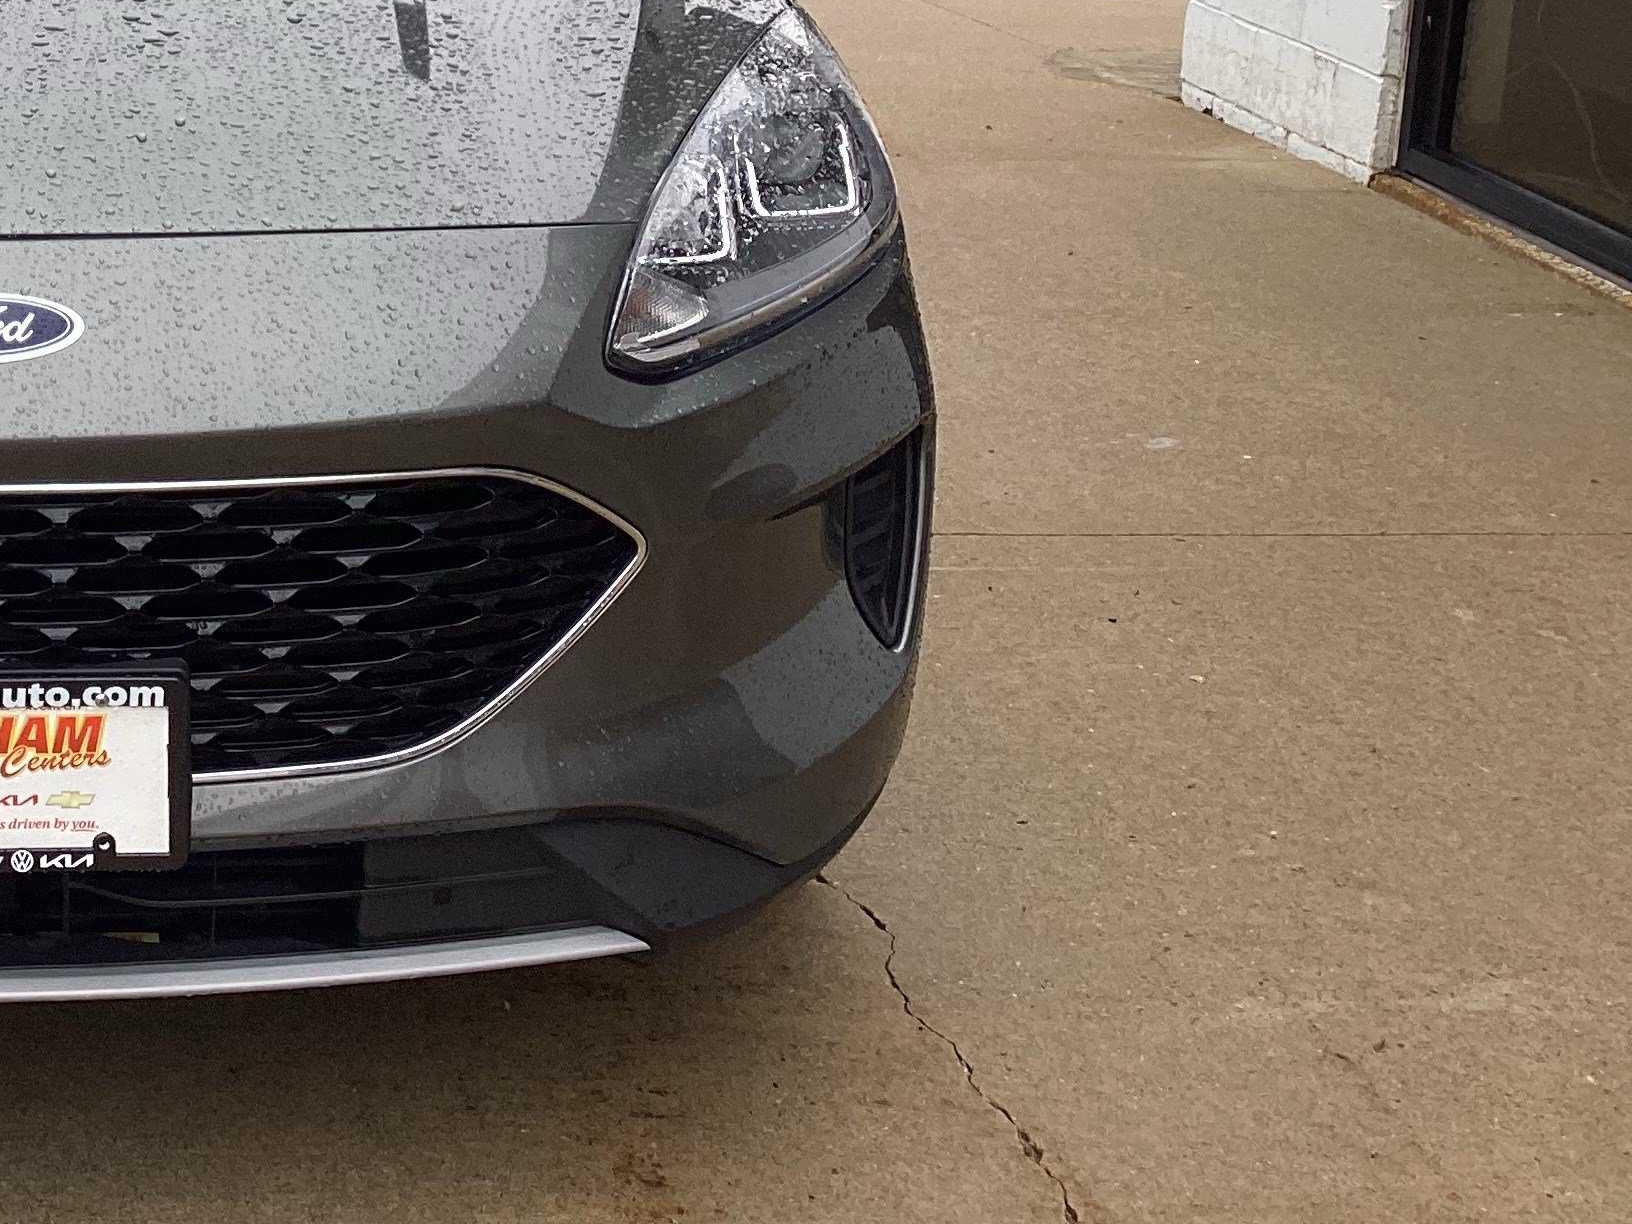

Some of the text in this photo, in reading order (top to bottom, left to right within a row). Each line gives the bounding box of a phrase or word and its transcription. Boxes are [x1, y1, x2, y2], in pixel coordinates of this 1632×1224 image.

[0, 744, 111, 778] Centers
[8, 818, 51, 830] driven
[54, 817, 70, 832] by
[71, 820, 100, 832] you.
